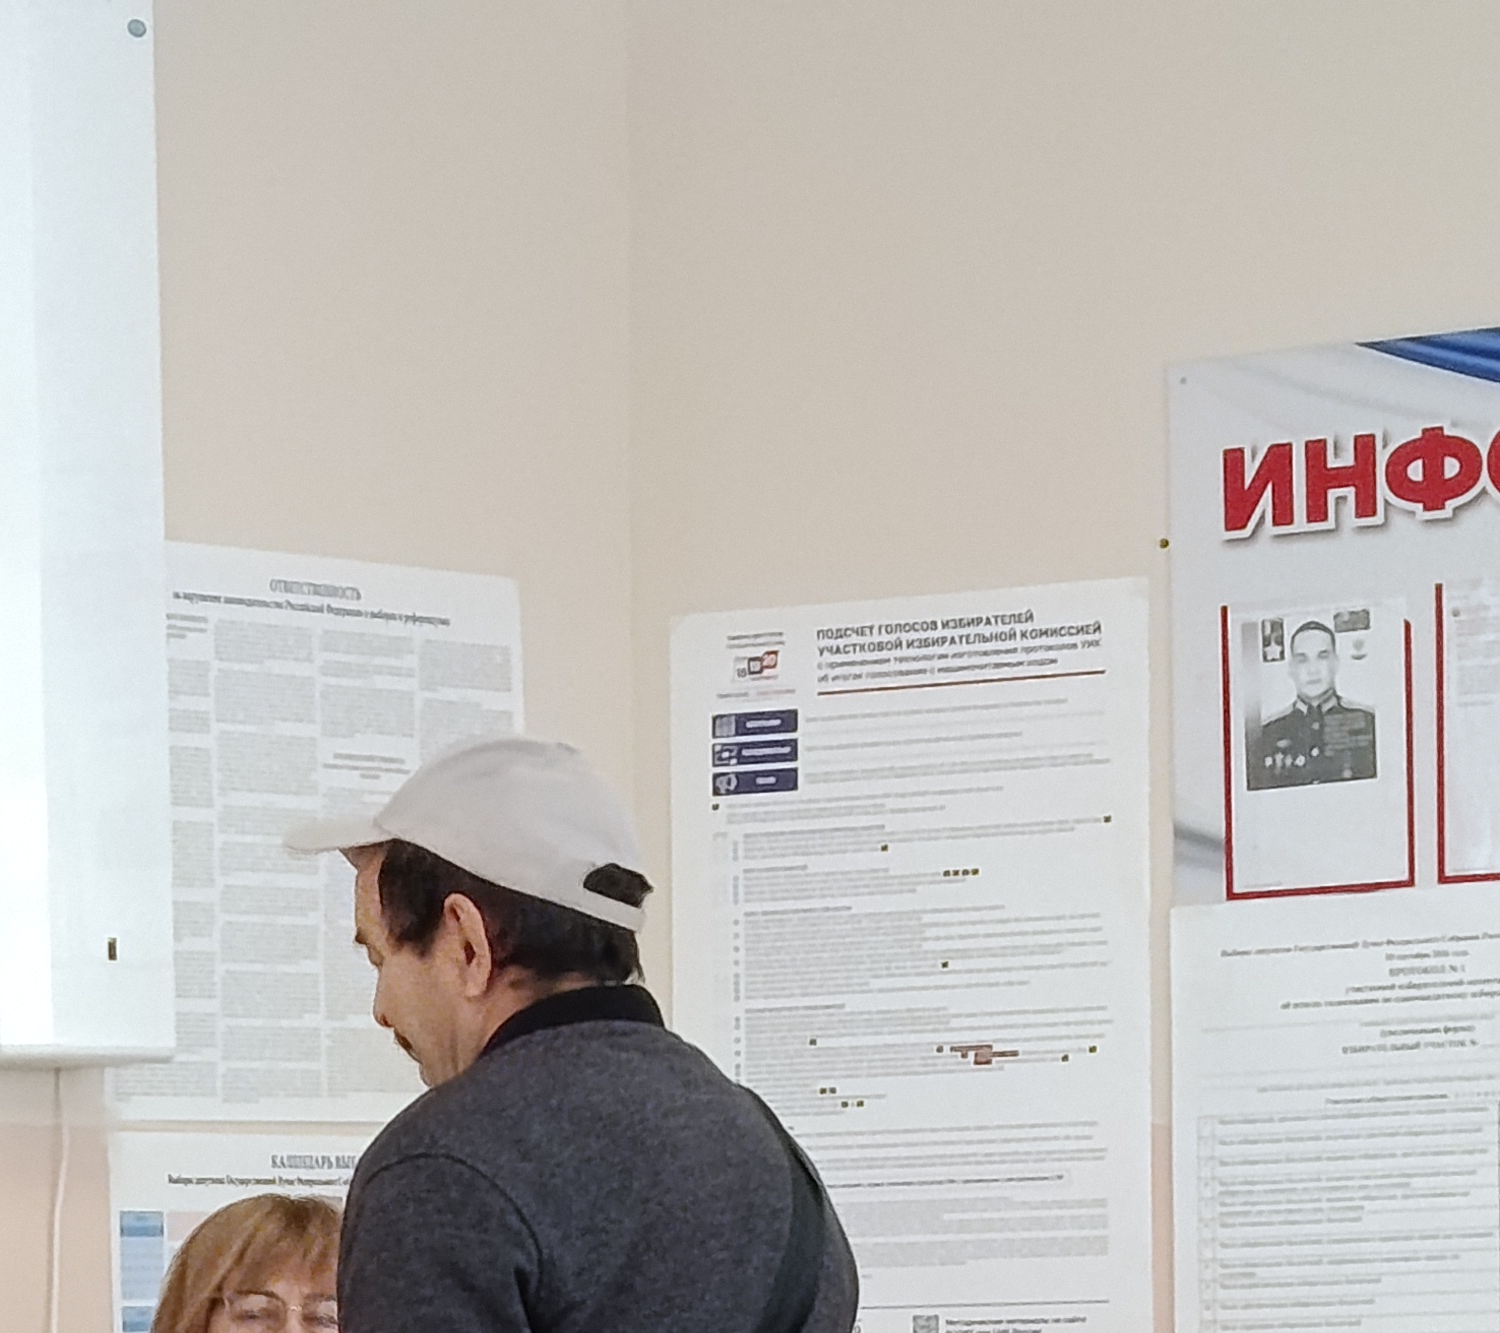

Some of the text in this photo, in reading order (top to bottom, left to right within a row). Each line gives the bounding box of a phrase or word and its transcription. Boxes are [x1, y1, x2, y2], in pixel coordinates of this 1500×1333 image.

[1222, 426, 1500, 534] ИНФ
[817, 609, 1034, 640] ПОДСЧЕТ ГОЛОСОВ ИЗБИРАТЕЛЕЙ
[817, 620, 1102, 657] УЧАСТКОВОЙ ИЗБИРАТЕЛЬНОЙ КОМИССИЕЙ
